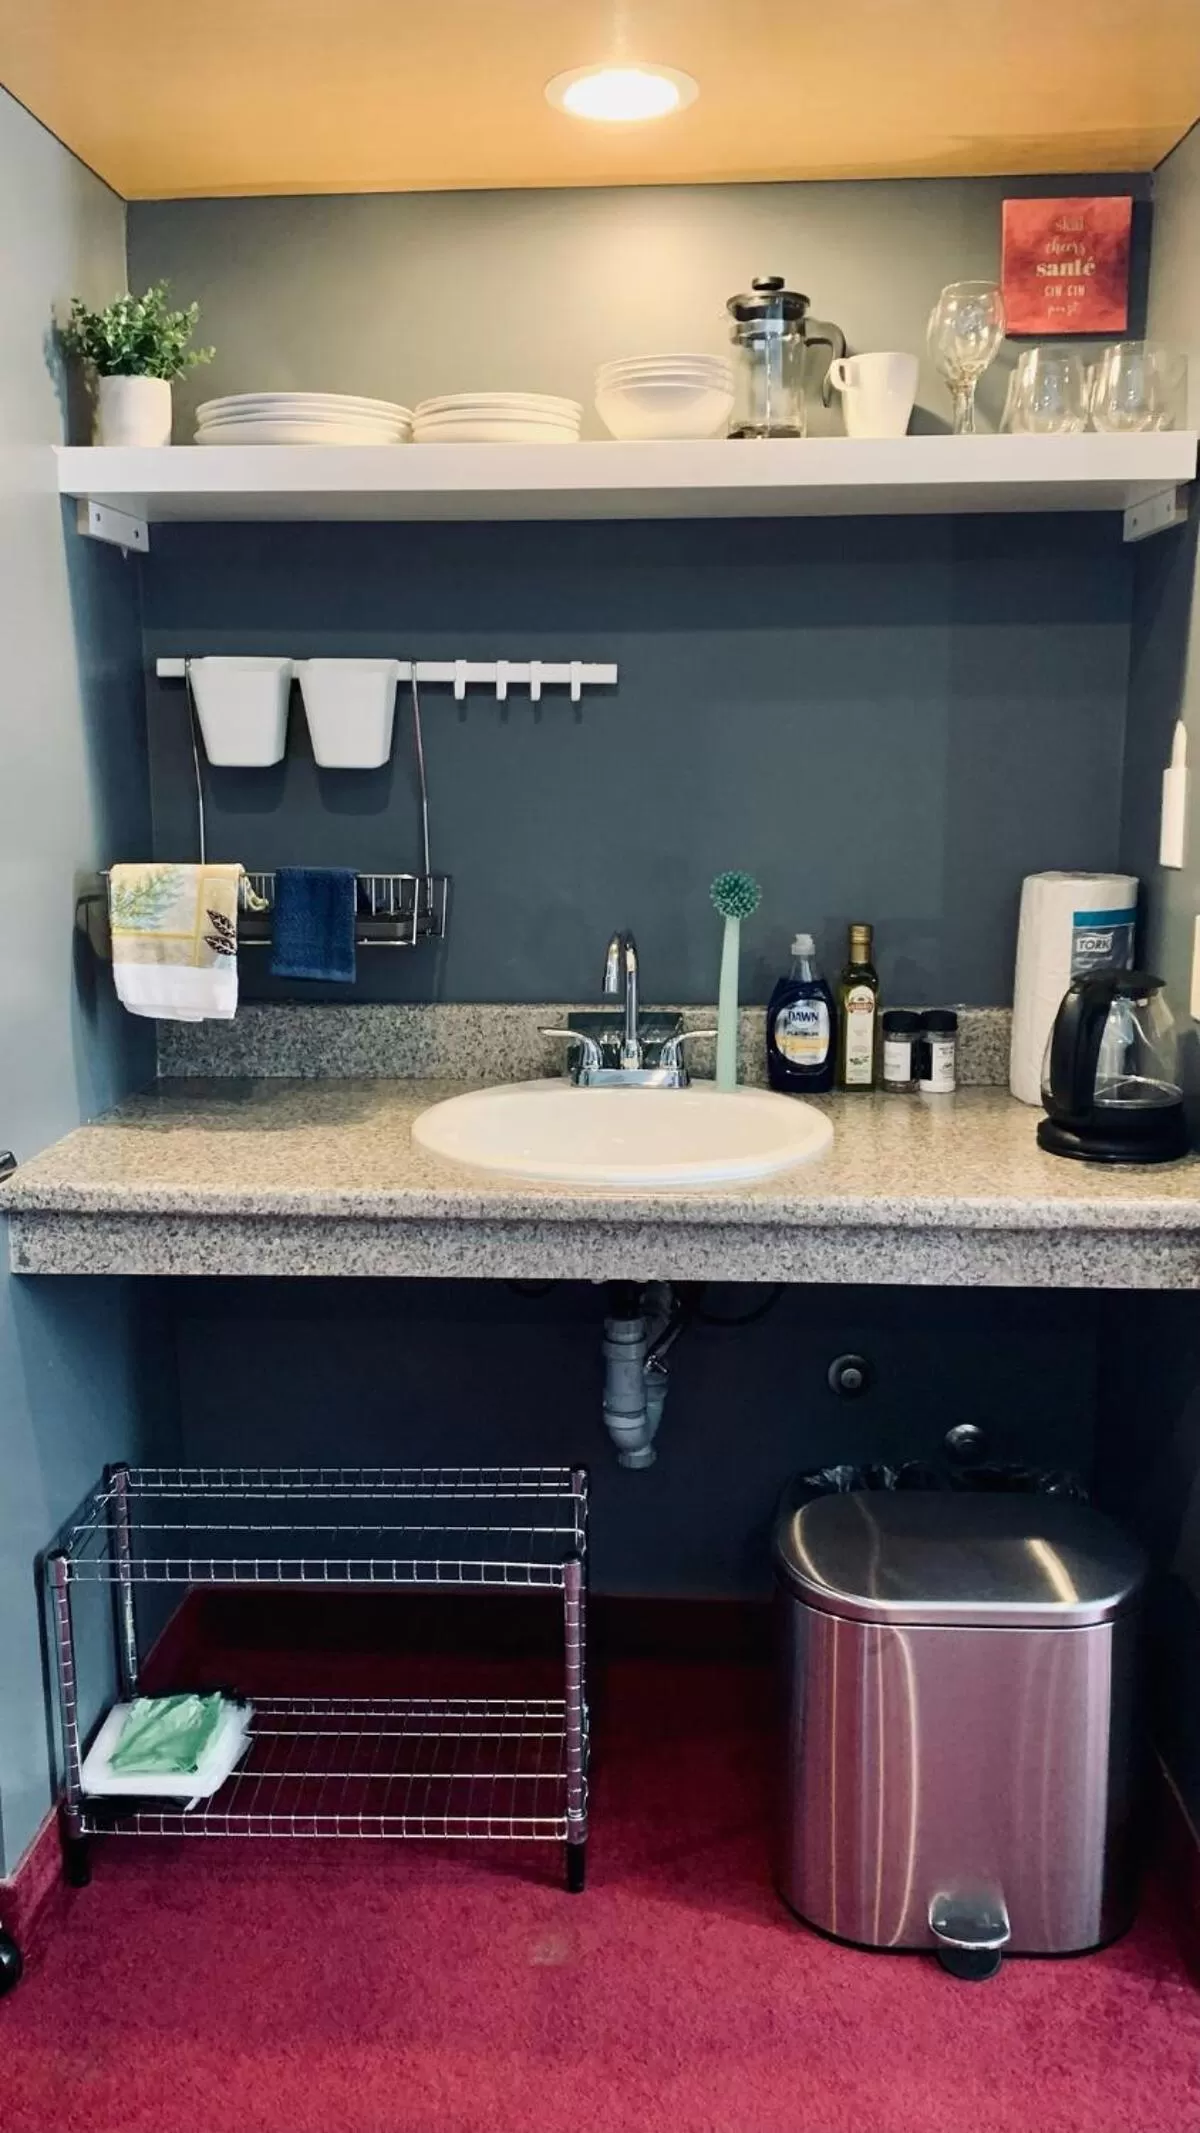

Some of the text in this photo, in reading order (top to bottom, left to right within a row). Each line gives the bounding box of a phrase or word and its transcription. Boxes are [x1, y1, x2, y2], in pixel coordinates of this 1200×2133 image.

[1036, 256, 1096, 277] santé
[1078, 938, 1111, 950] TORK
[788, 1010, 819, 1021] DAWN
